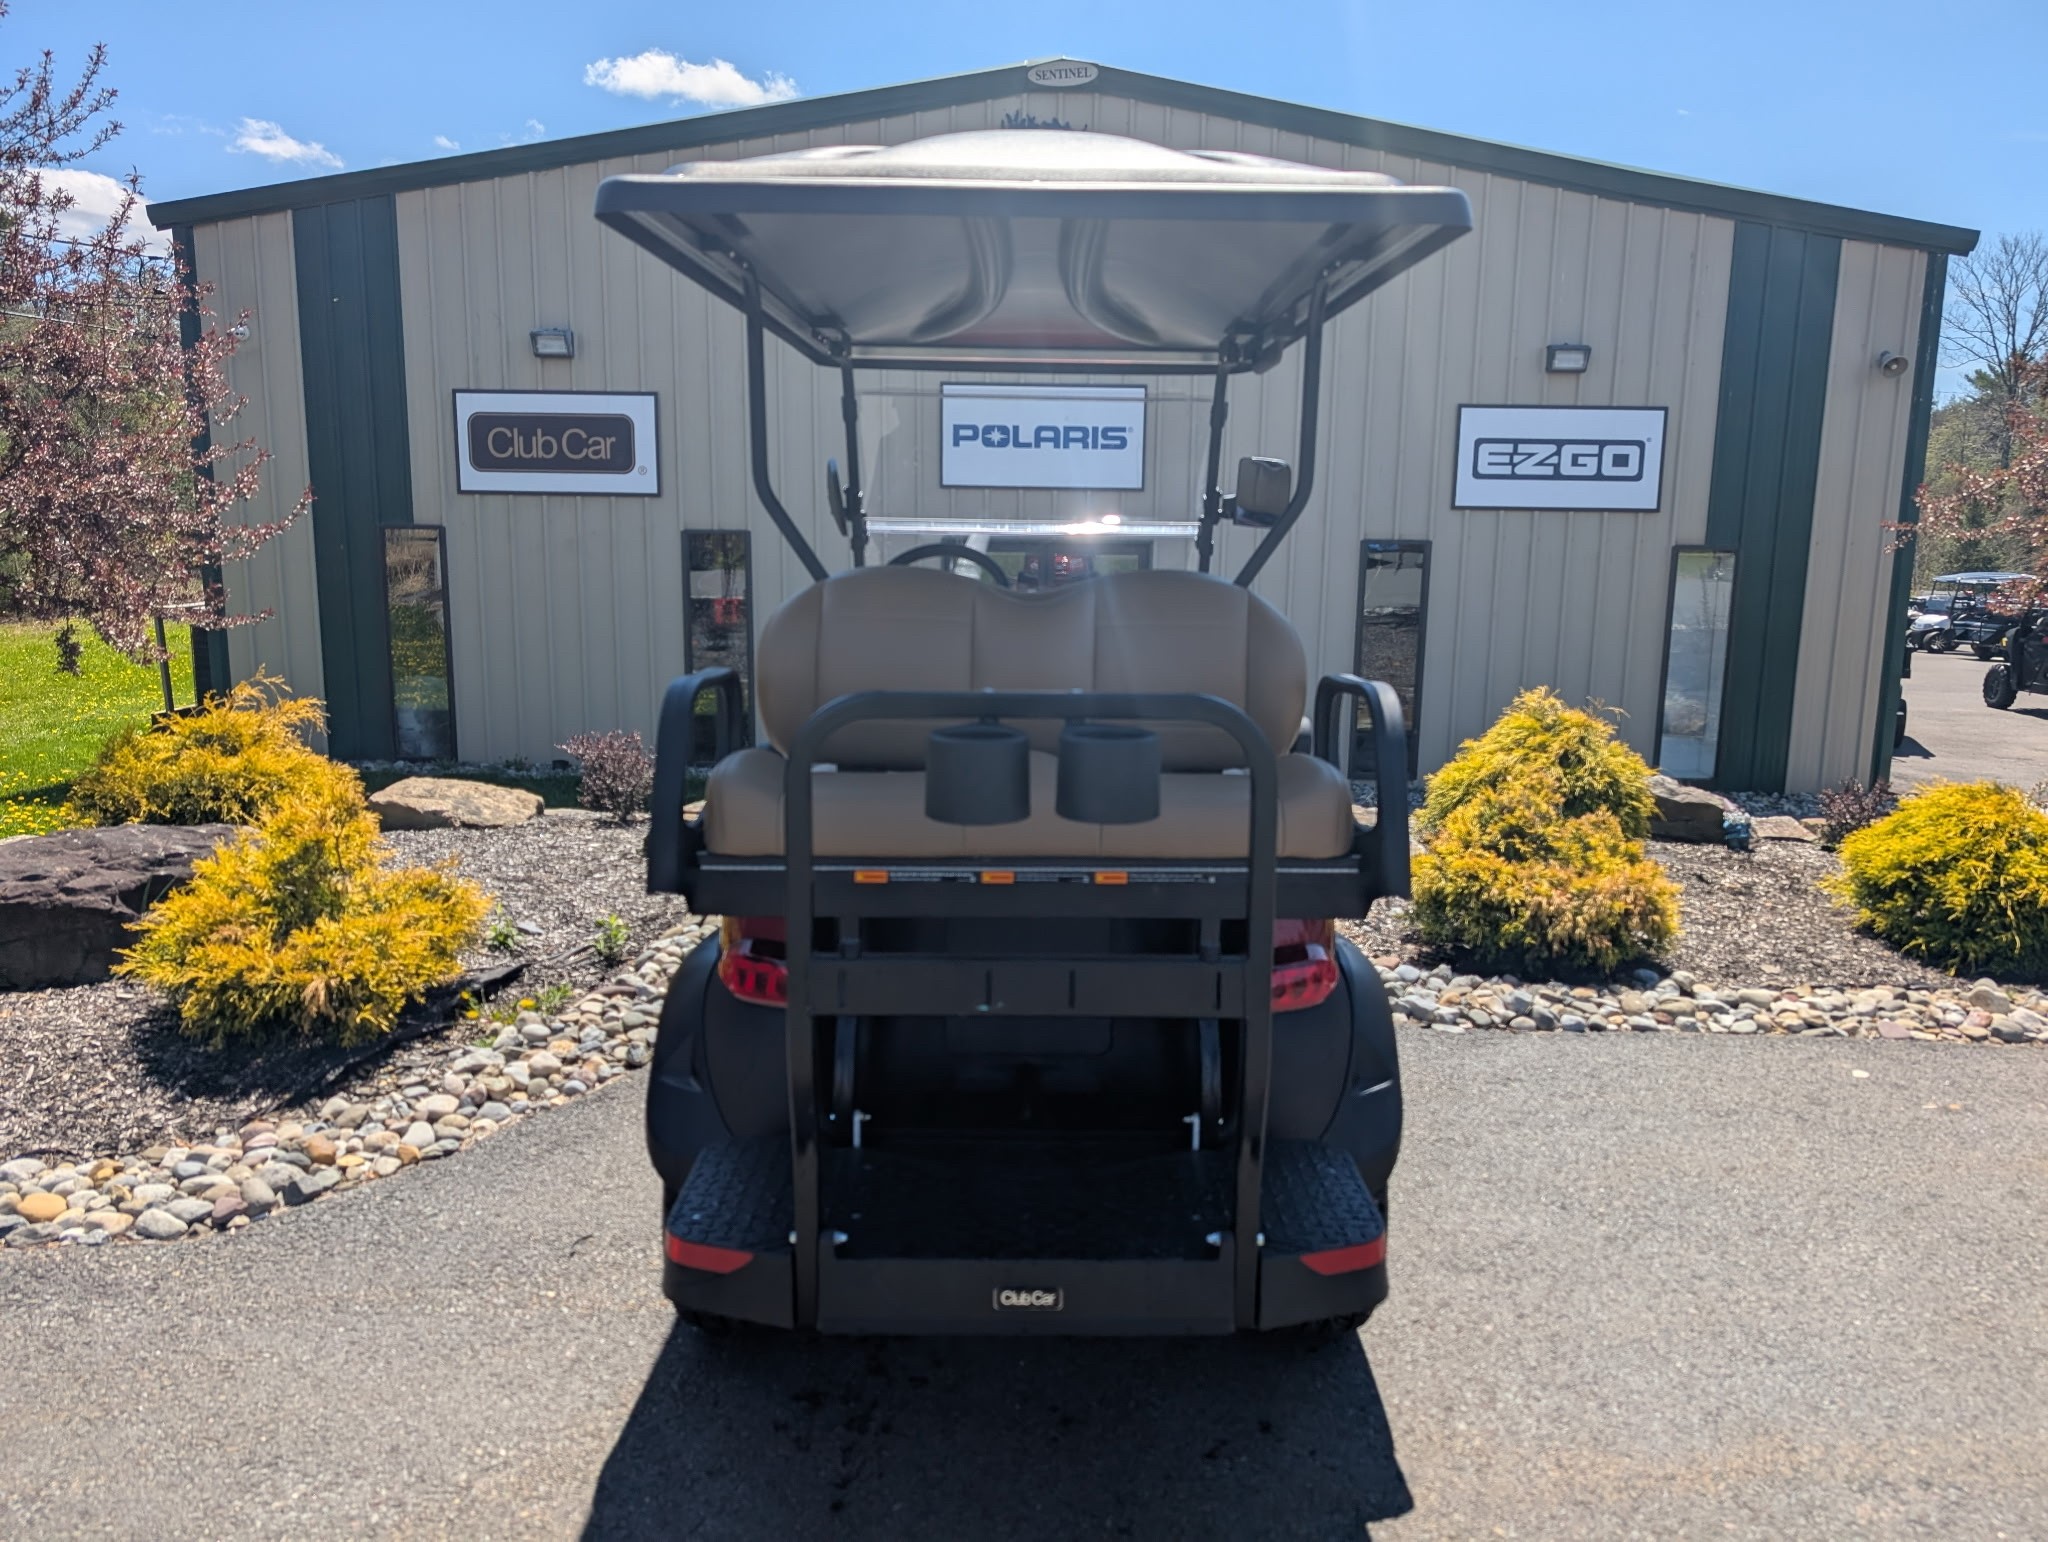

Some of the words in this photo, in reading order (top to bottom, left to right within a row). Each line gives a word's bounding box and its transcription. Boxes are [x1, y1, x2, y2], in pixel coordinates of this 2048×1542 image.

[1035, 67, 1091, 80] SENTINEL
[487, 427, 557, 458] Club
[561, 428, 616, 460] Car
[952, 424, 1128, 450] POLARIS
[1477, 443, 1640, 477] EZGO
